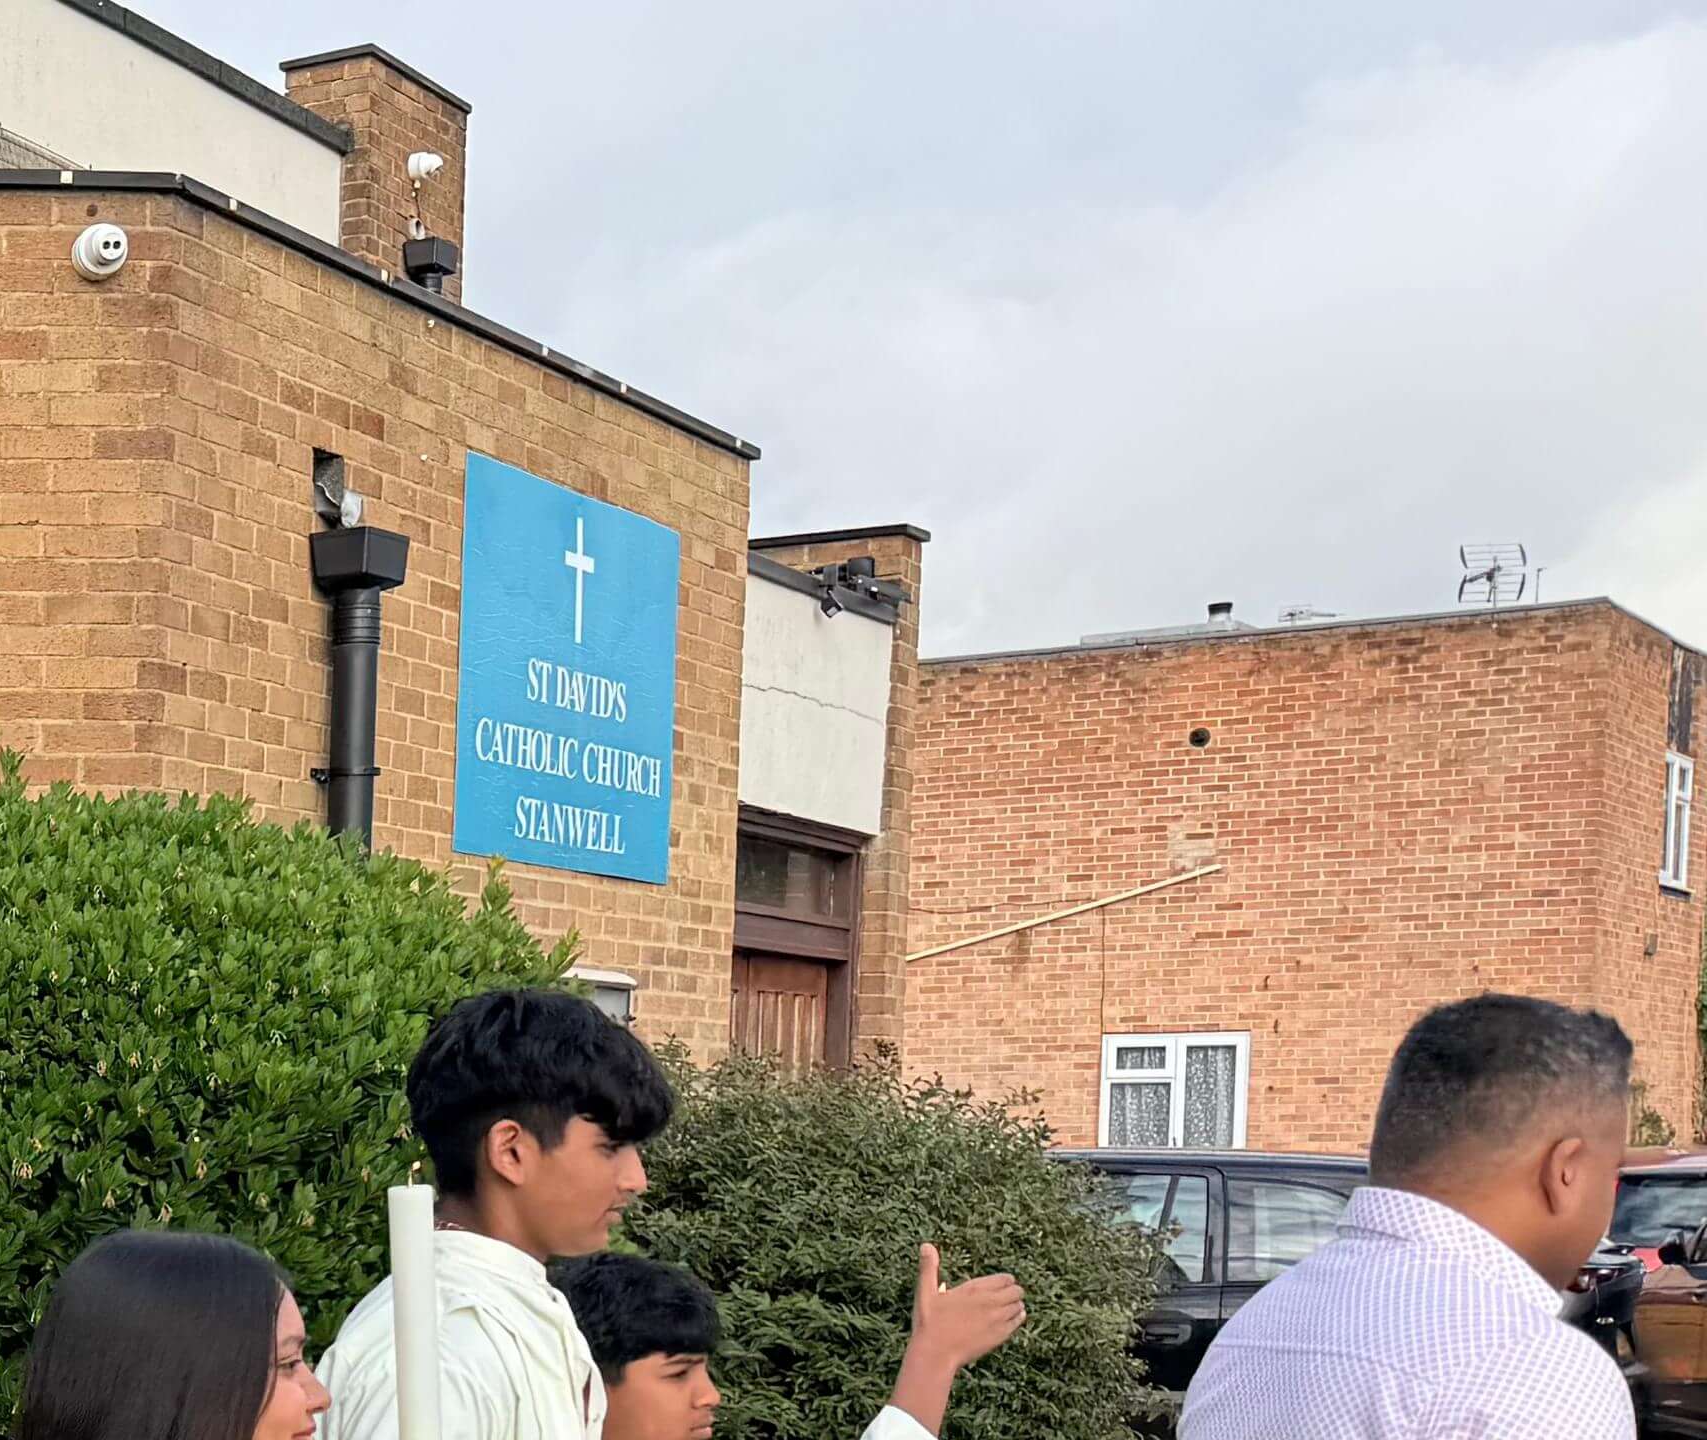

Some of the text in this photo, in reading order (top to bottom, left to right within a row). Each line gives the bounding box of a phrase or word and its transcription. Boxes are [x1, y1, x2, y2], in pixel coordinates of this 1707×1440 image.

[526, 657, 628, 723] ST DAVID'S
[474, 716, 662, 798] CATHOLIC CHURCH
[514, 795, 626, 855] STANWELL
